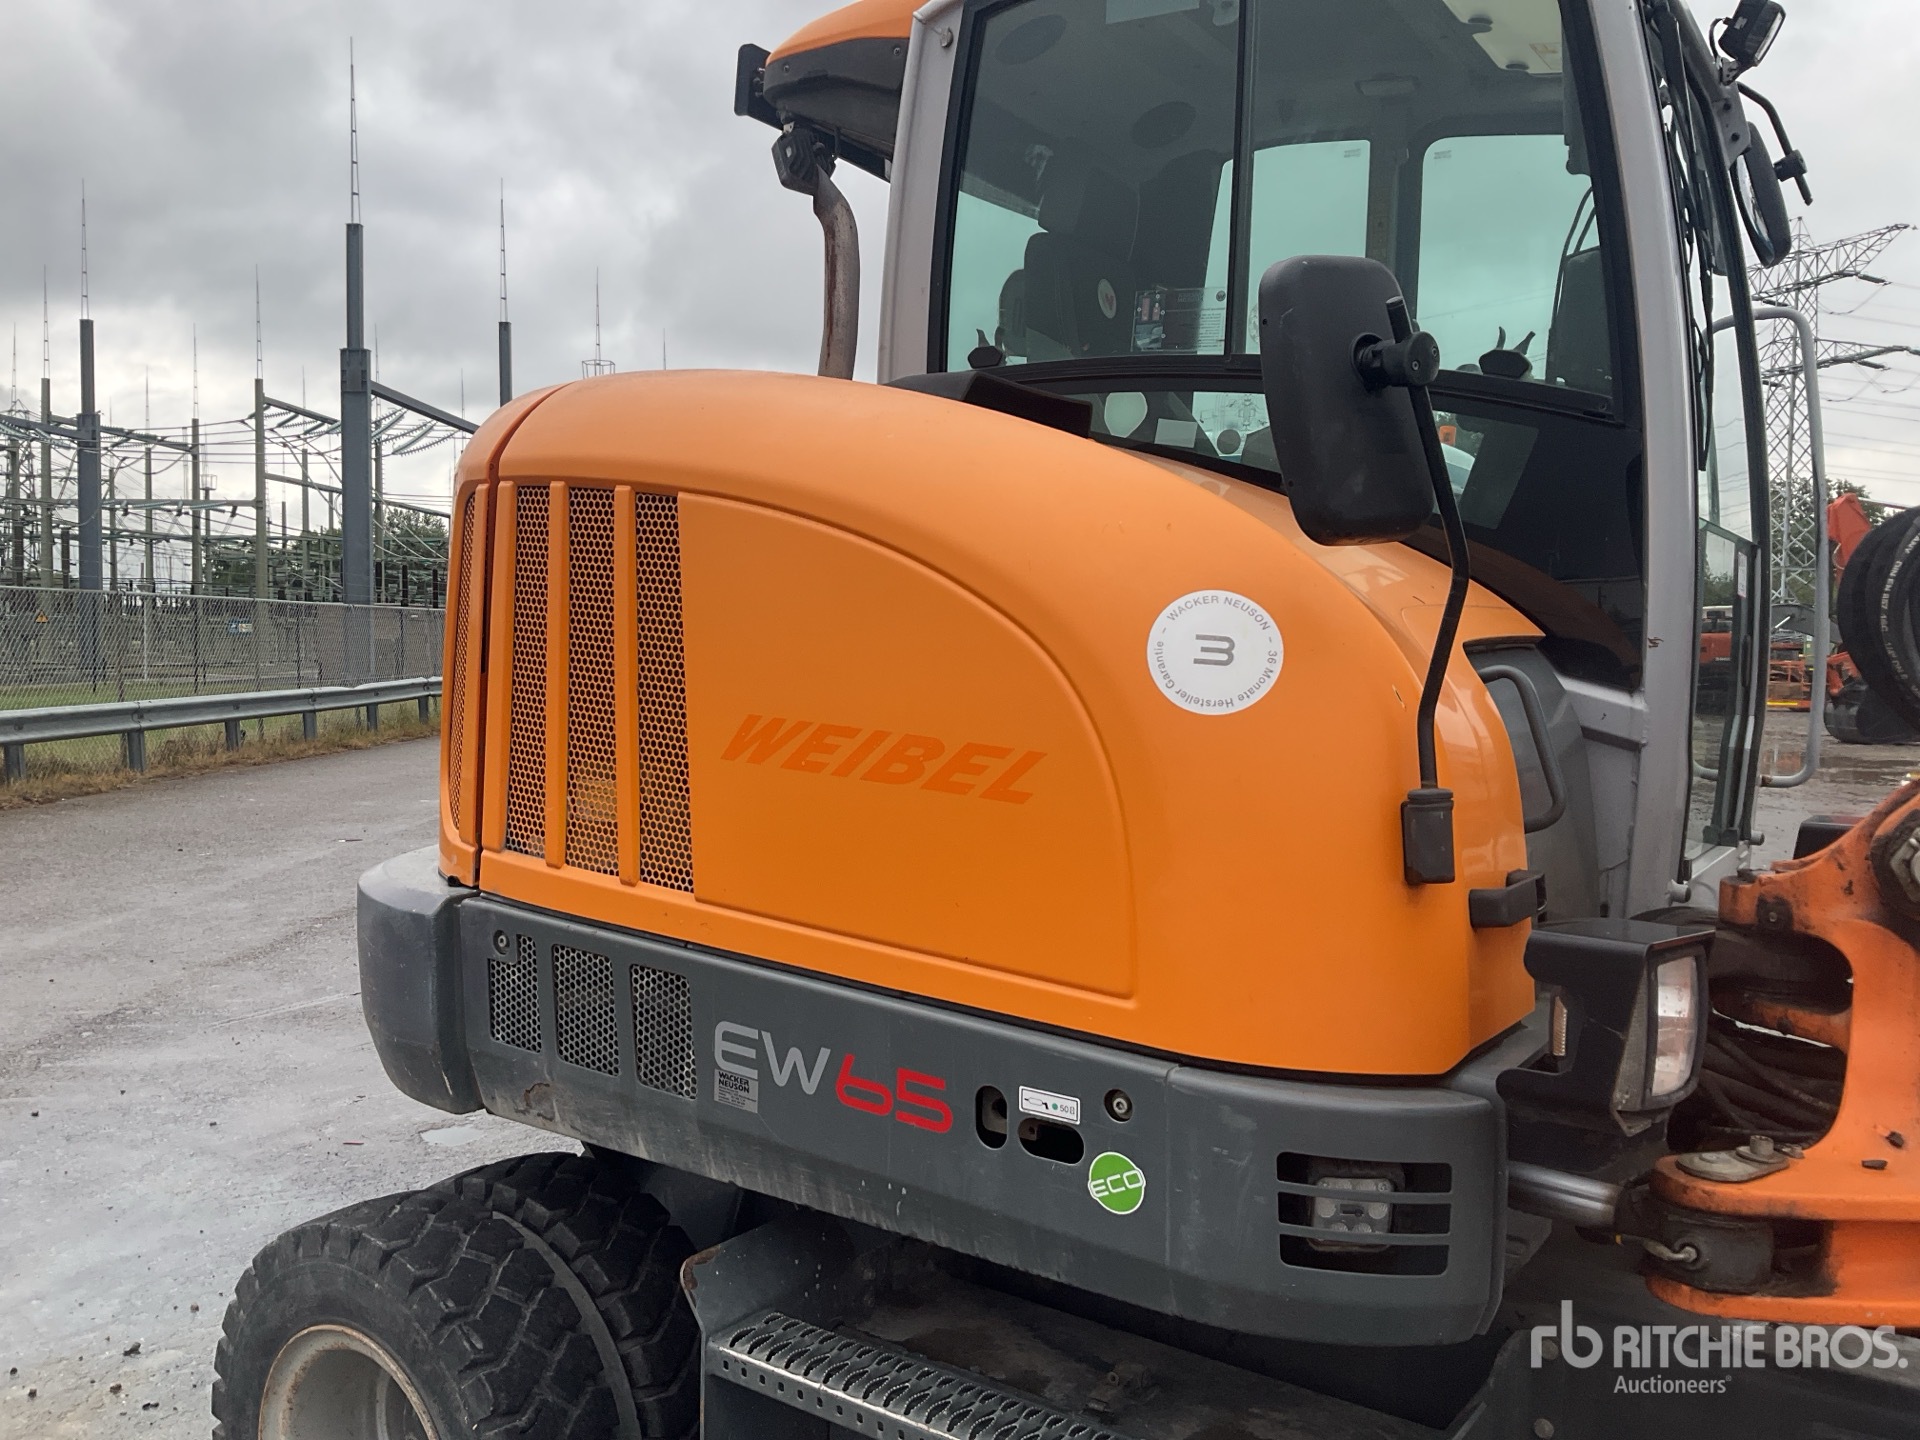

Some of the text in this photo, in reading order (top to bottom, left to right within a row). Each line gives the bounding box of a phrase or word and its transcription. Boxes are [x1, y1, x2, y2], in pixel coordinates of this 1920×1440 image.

[1166, 595, 1271, 631] WACKER NEUSON
[1154, 641, 1278, 708] 36 Monate Hersteller Garantie
[720, 714, 1048, 805] WEIBEL
[718, 1071, 750, 1087] WACKER
[718, 1078, 750, 1094] NEUSON
[1089, 1169, 1145, 1198] ECO
